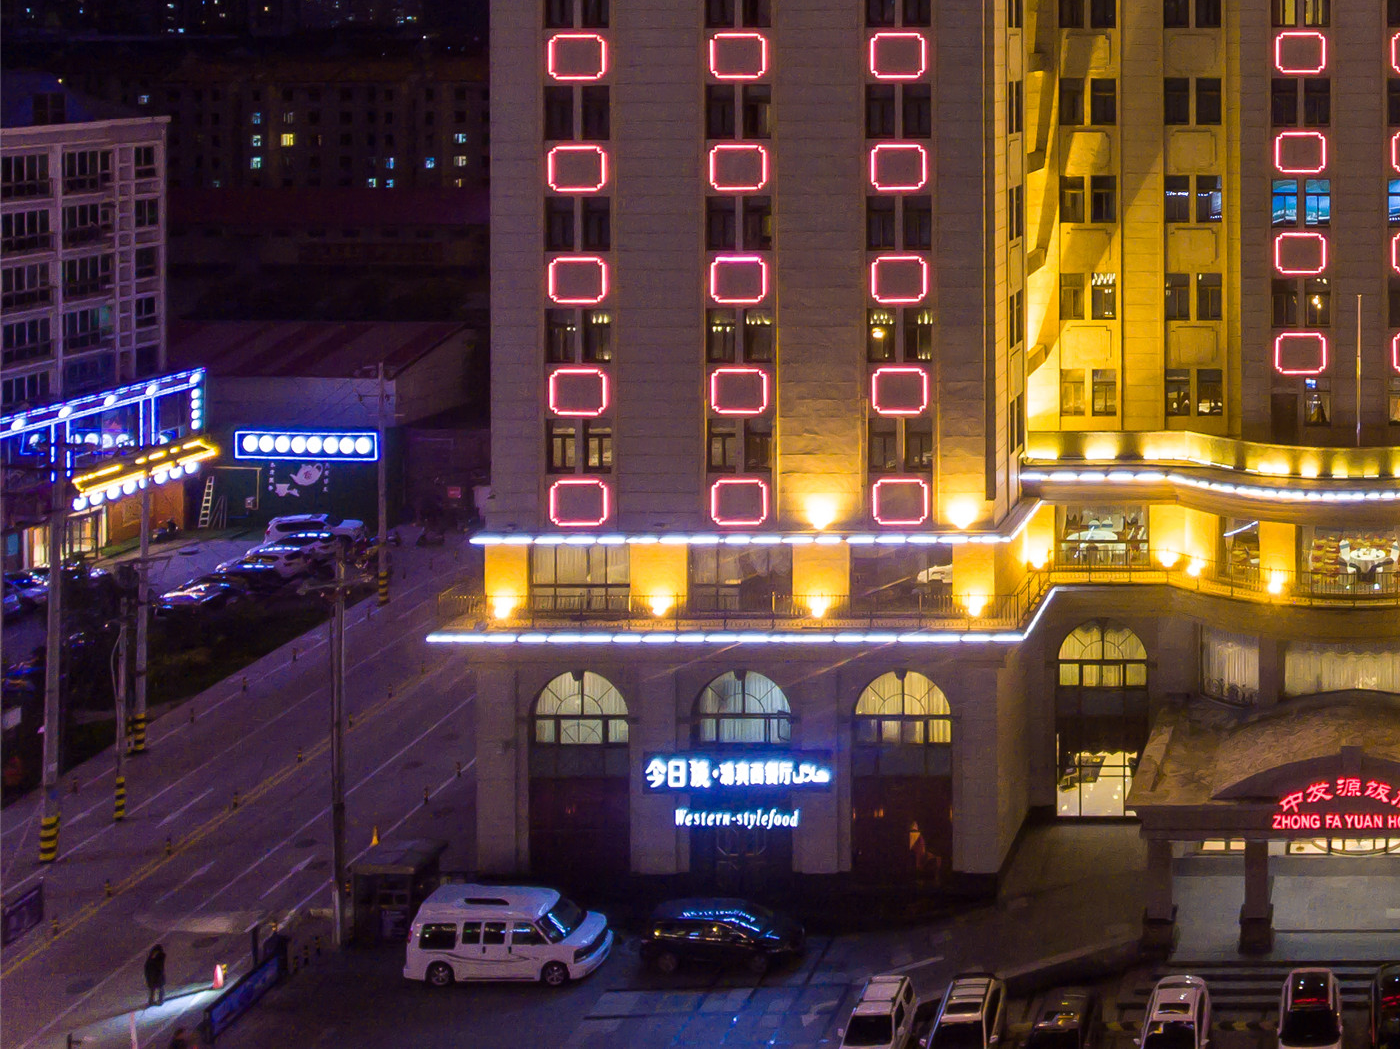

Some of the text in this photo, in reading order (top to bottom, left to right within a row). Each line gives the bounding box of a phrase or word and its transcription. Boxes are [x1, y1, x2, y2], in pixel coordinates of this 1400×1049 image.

[1272, 815, 1321, 829] ZHONG
[1325, 815, 1342, 829] FA
[1344, 815, 1383, 829] YUAN
